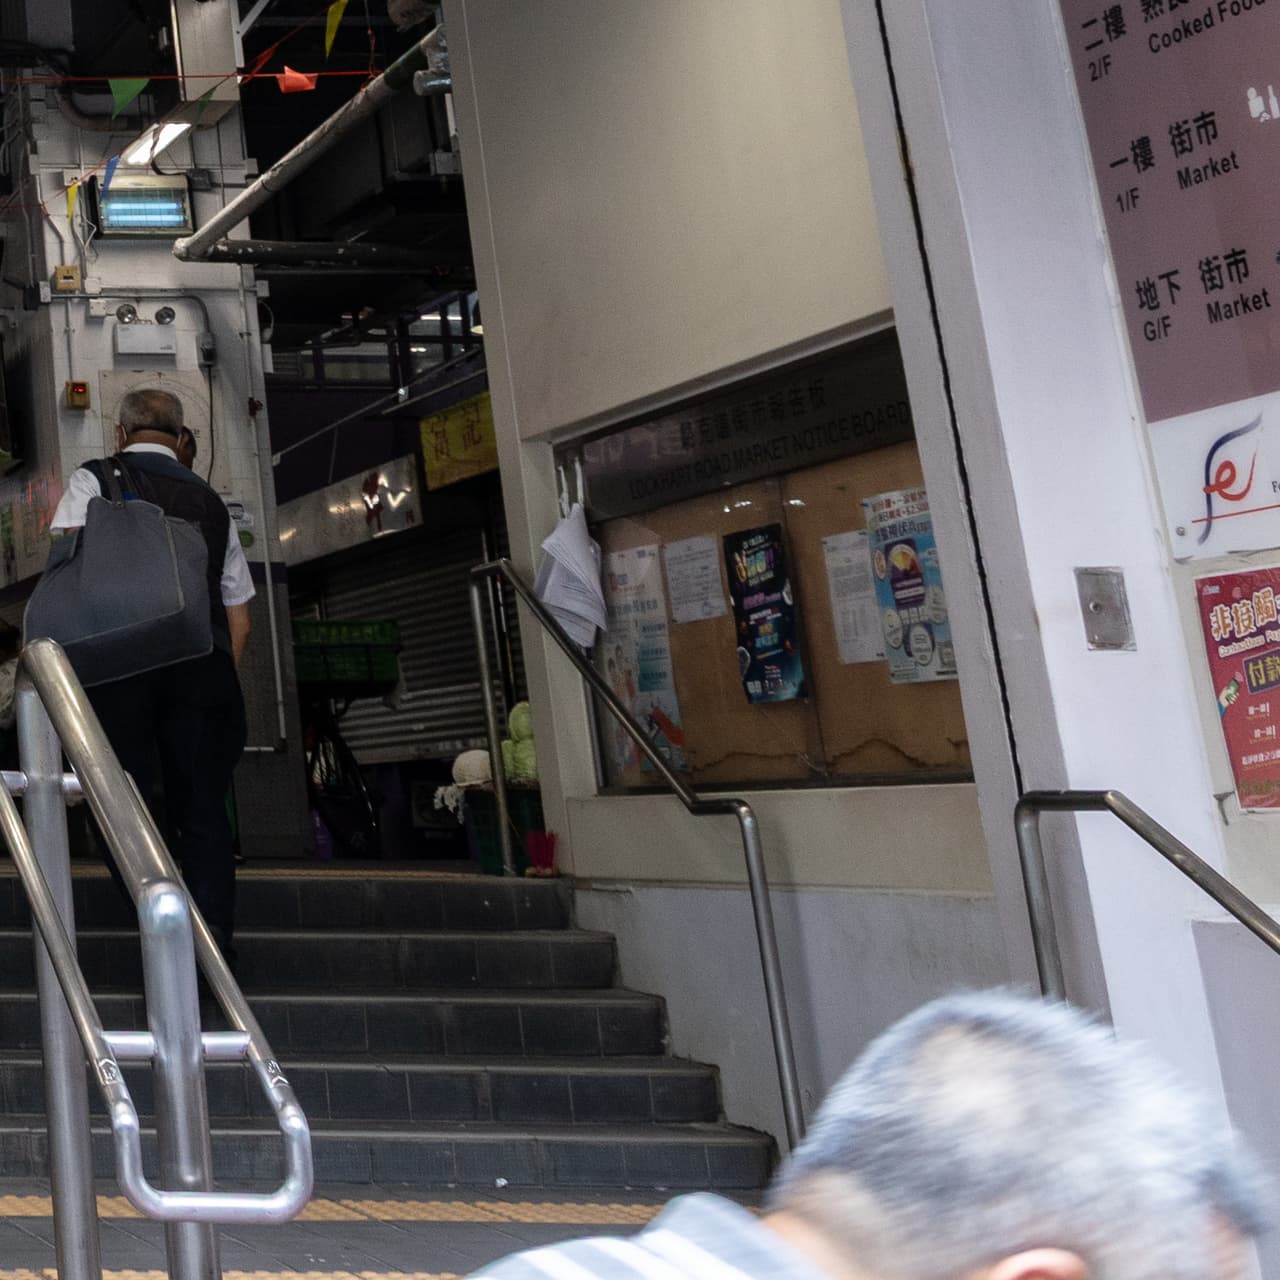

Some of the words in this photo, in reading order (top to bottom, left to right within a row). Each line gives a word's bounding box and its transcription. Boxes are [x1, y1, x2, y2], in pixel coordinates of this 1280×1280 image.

[1081, 4, 1128, 52] 二樓
[1088, 53, 1113, 83] 2/F
[1147, 7, 1215, 54] Cooked
[1109, 135, 1156, 174] 一樓
[1168, 111, 1219, 159] 街市
[1115, 186, 1141, 214] 1/F
[1176, 149, 1240, 190] Market
[1134, 268, 1182, 312] 地下
[1197, 247, 1251, 295] 街市
[1143, 314, 1173, 342] G/F
[1206, 287, 1272, 325] Market
[628, 460, 696, 500] LOCKHART
[695, 453, 730, 482] ROAD
[730, 435, 788, 469] MARKET
[792, 416, 850, 453] NOTICE
[1210, 586, 1280, 641] 非接觸
